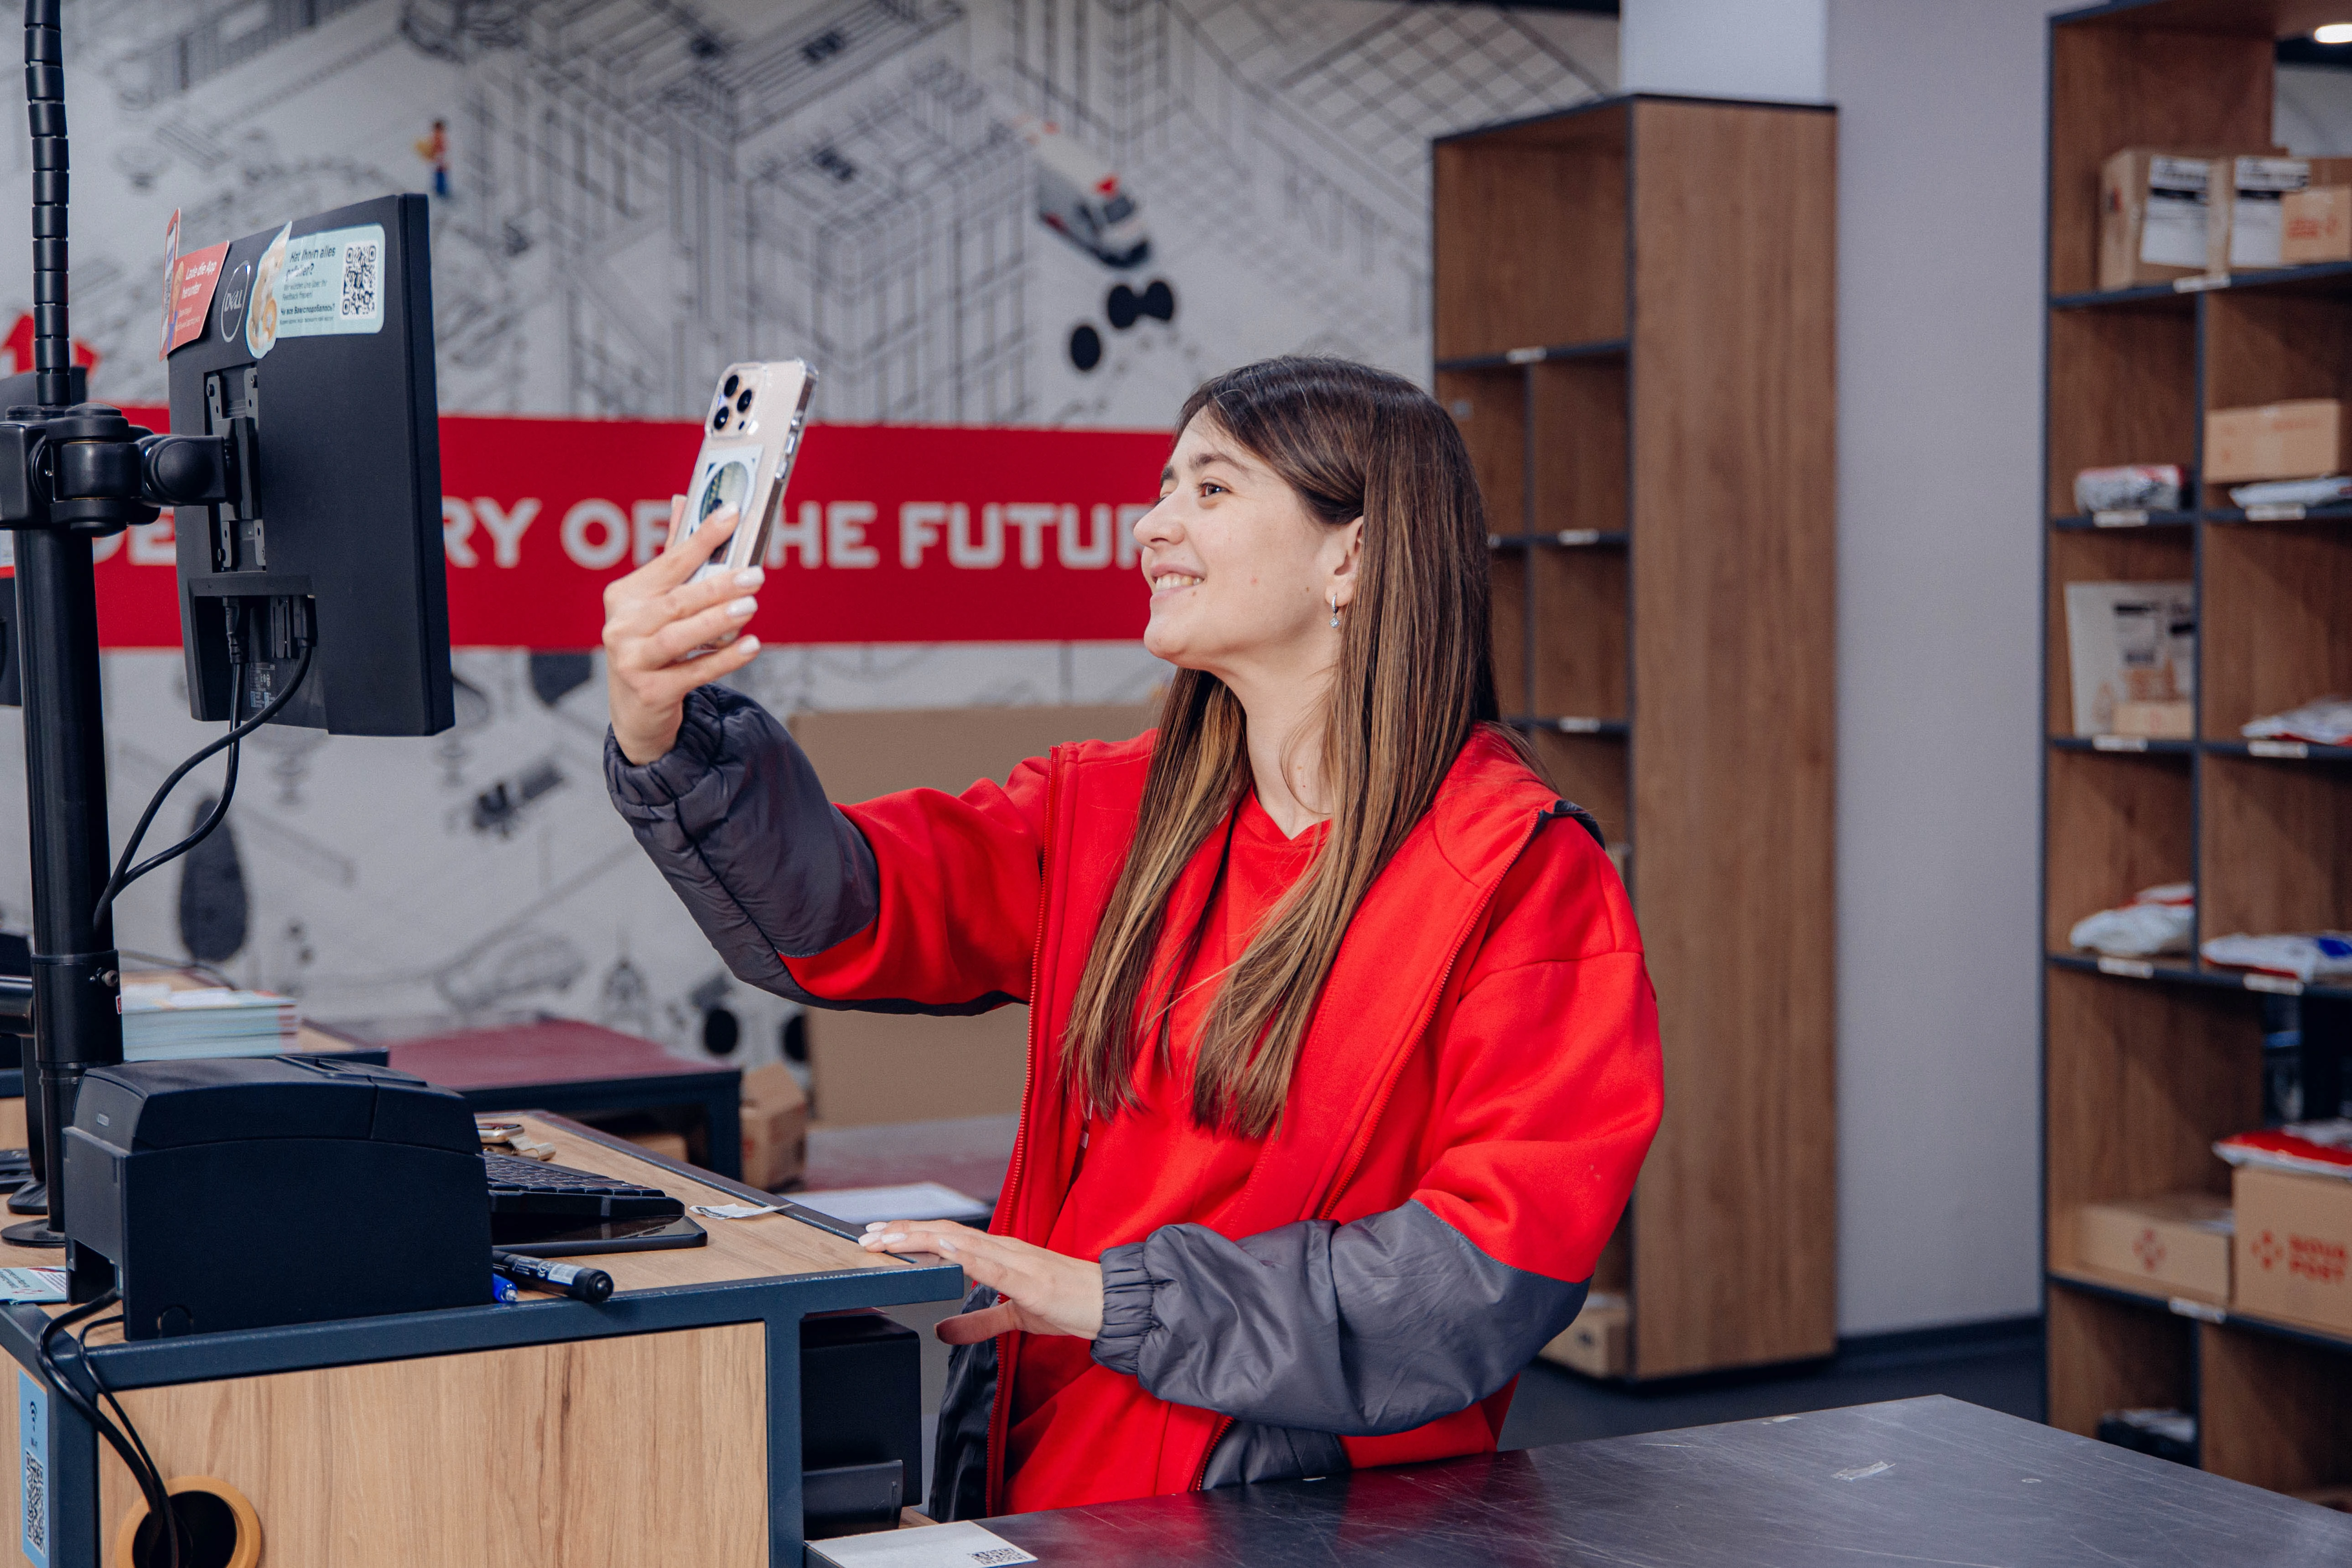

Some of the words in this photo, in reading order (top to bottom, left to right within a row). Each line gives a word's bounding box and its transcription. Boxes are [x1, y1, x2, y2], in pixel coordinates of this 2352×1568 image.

[320, 245, 336, 258] alles
[224, 290, 243, 312] DELL
[763, 500, 880, 570] HE
[898, 501, 1154, 570] FUTUR
